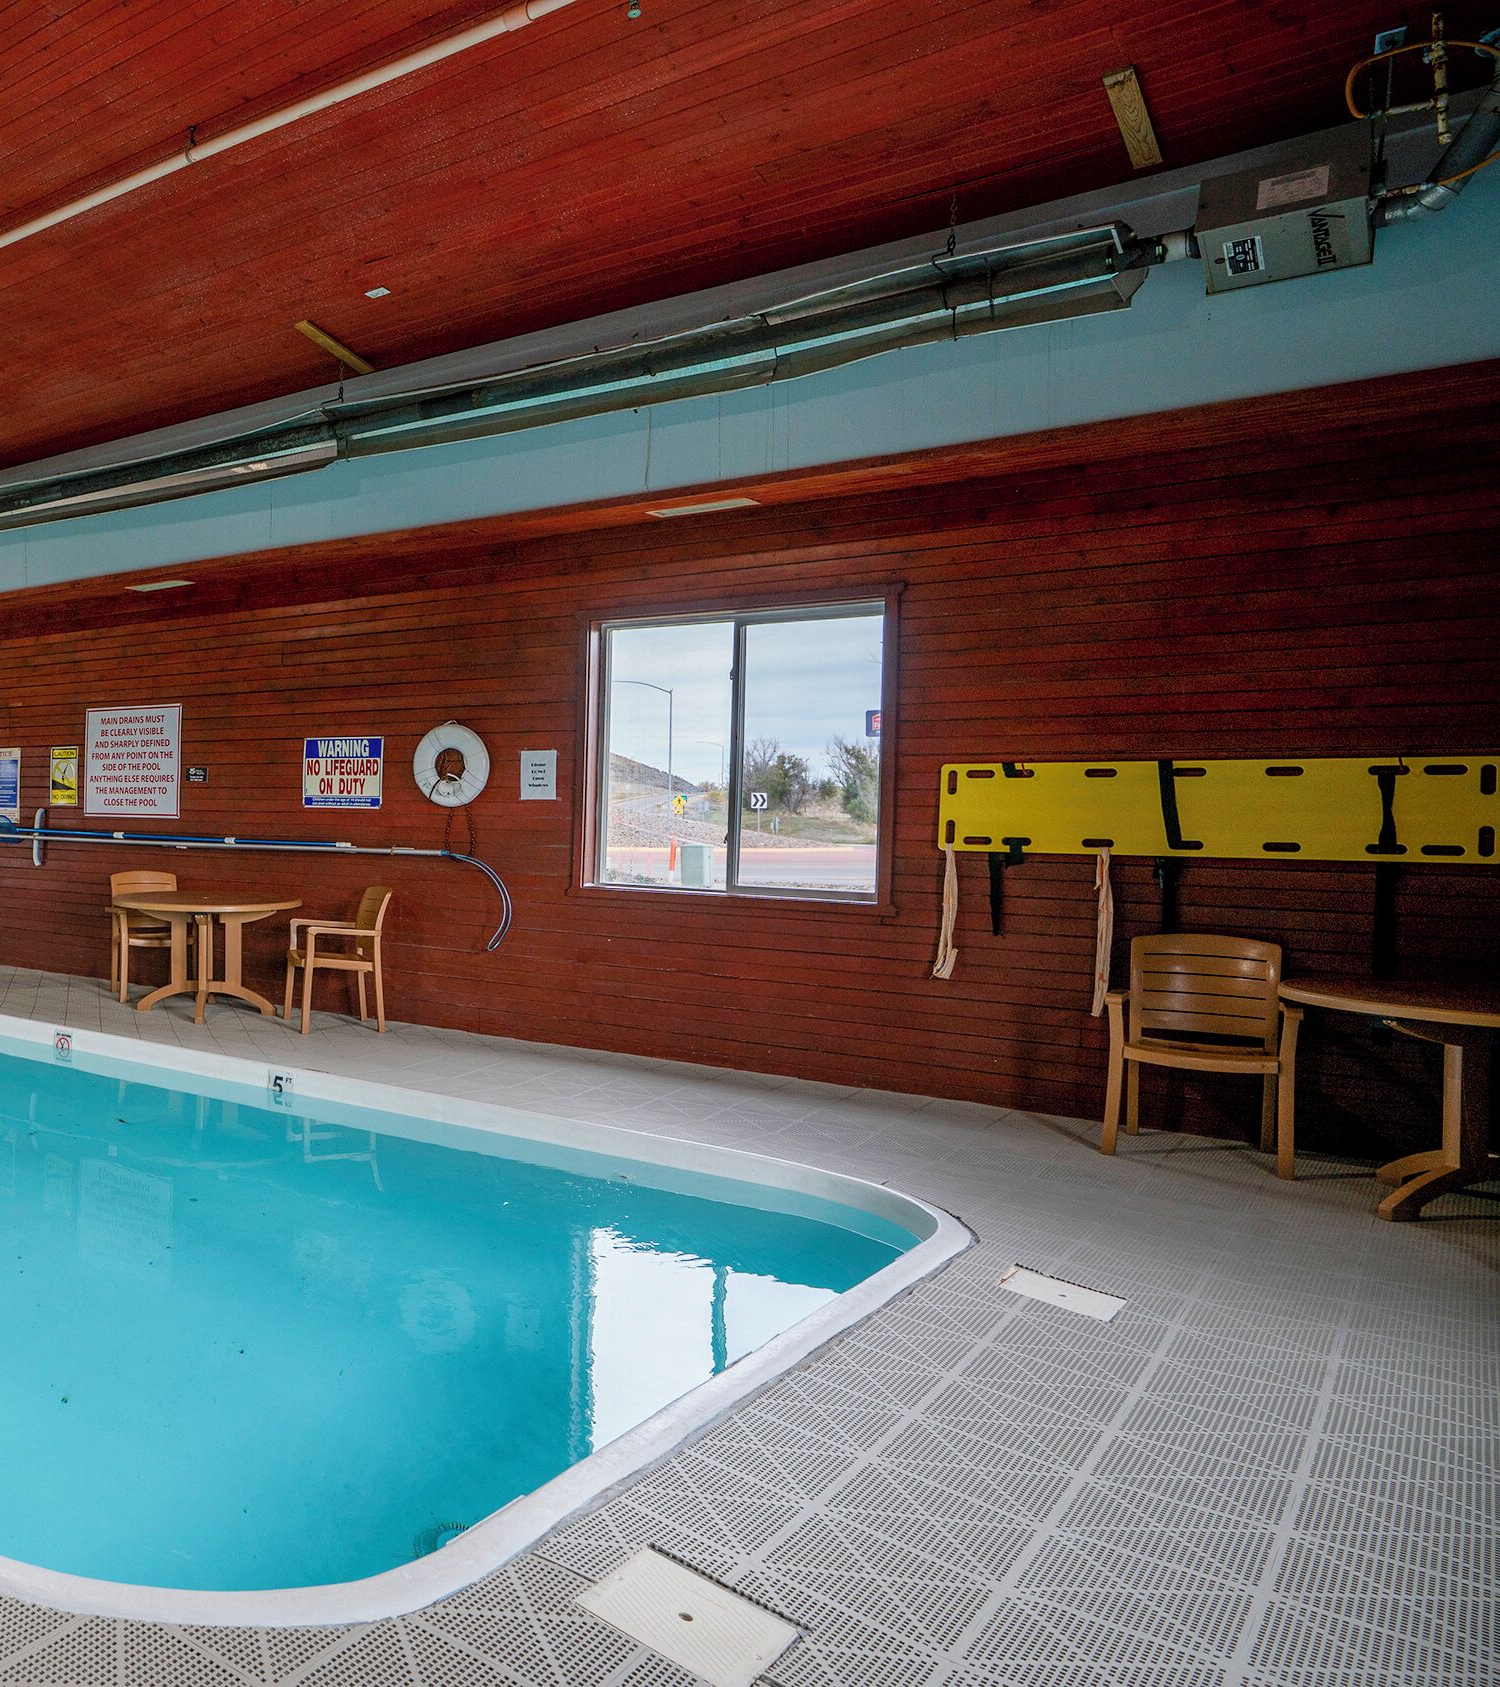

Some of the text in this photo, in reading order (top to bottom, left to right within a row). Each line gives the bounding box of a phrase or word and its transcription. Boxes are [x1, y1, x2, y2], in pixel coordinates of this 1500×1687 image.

[1307, 208, 1345, 260] VANTAGE
[100, 715, 165, 725] MAIN DRAINS MUST
[100, 727, 164, 737] BE CLEARLY VISIBLE
[95, 739, 170, 749] AND SHARPLY DEFINED
[318, 740, 369, 757] WARNING
[91, 751, 173, 760] FROM ANY POINT ON THE
[102, 763, 161, 771] SIDE OF THE POOL
[306, 759, 379, 776] NO LIFEGUARD
[89, 775, 175, 784] ANYTHING ELSE REQUIRES
[95, 786, 168, 795] THE MANAGEMENT TO
[319, 777, 366, 795] ON DUTY
[103, 799, 157, 807] CLOSE THE POOL
[273, 1075, 283, 1093] 5
